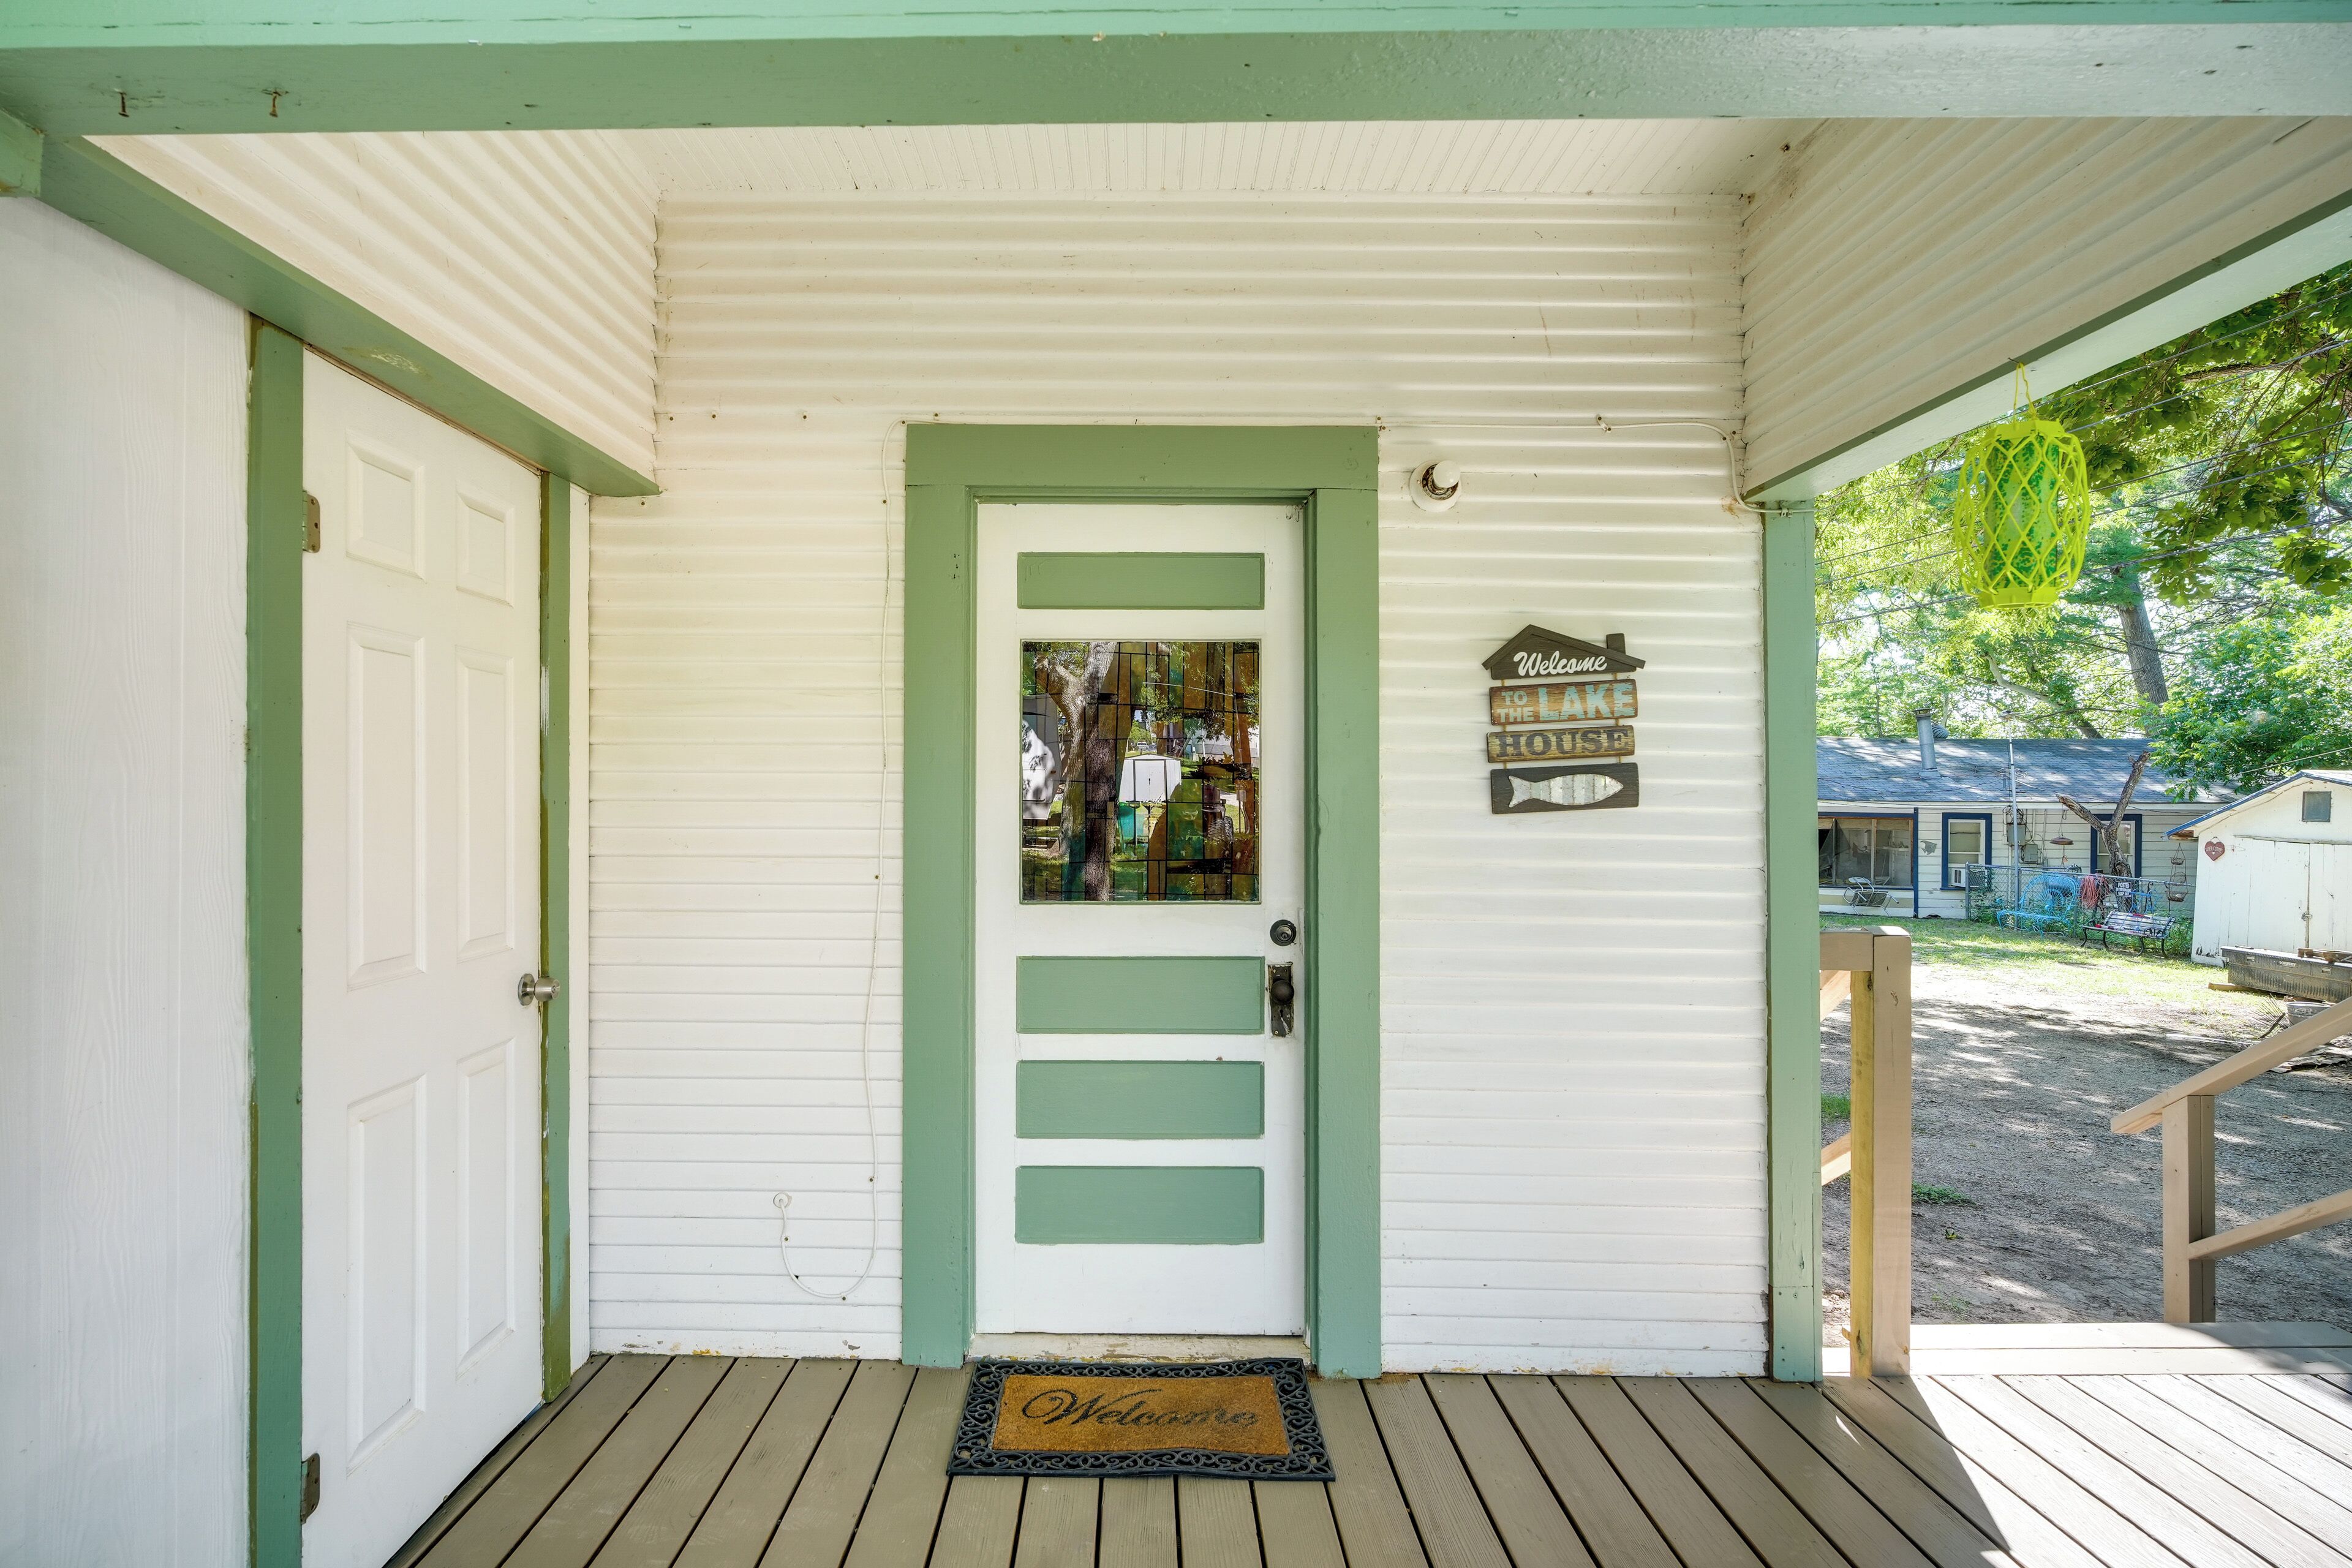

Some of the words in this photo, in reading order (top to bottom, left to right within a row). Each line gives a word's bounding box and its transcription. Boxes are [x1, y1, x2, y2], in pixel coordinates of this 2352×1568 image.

[1513, 650, 1608, 676] Welcome
[1501, 690, 1528, 706] TO
[1537, 683, 1636, 722] LAKE
[1498, 706, 1534, 723] THE
[1496, 729, 1629, 758] HOUSE
[1022, 1389, 1259, 1427] Welcome
